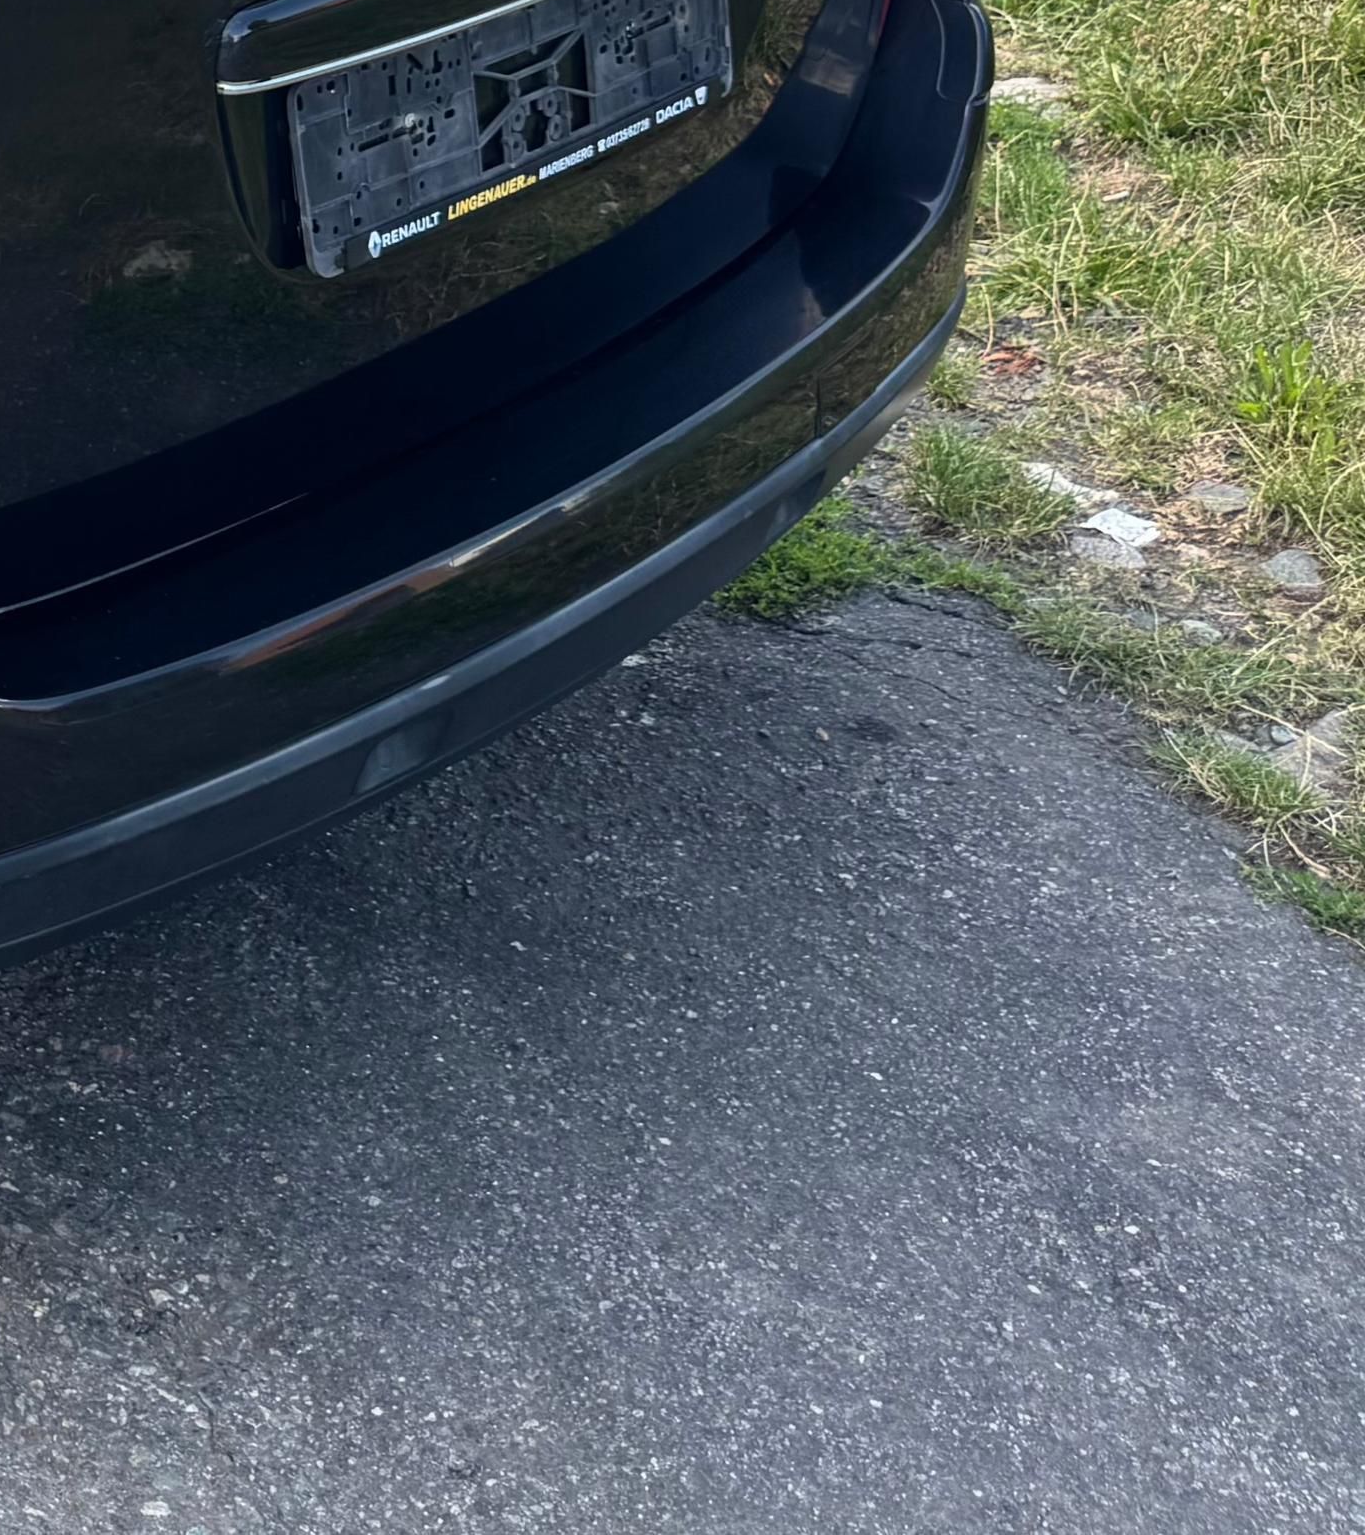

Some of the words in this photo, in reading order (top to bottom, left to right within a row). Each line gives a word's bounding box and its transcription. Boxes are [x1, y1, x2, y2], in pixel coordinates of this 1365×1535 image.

[381, 212, 441, 247] RENAULT
[448, 174, 537, 221] LINGENAUER.de
[539, 145, 595, 180] MARIENBERG
[656, 96, 694, 124] DACIA
